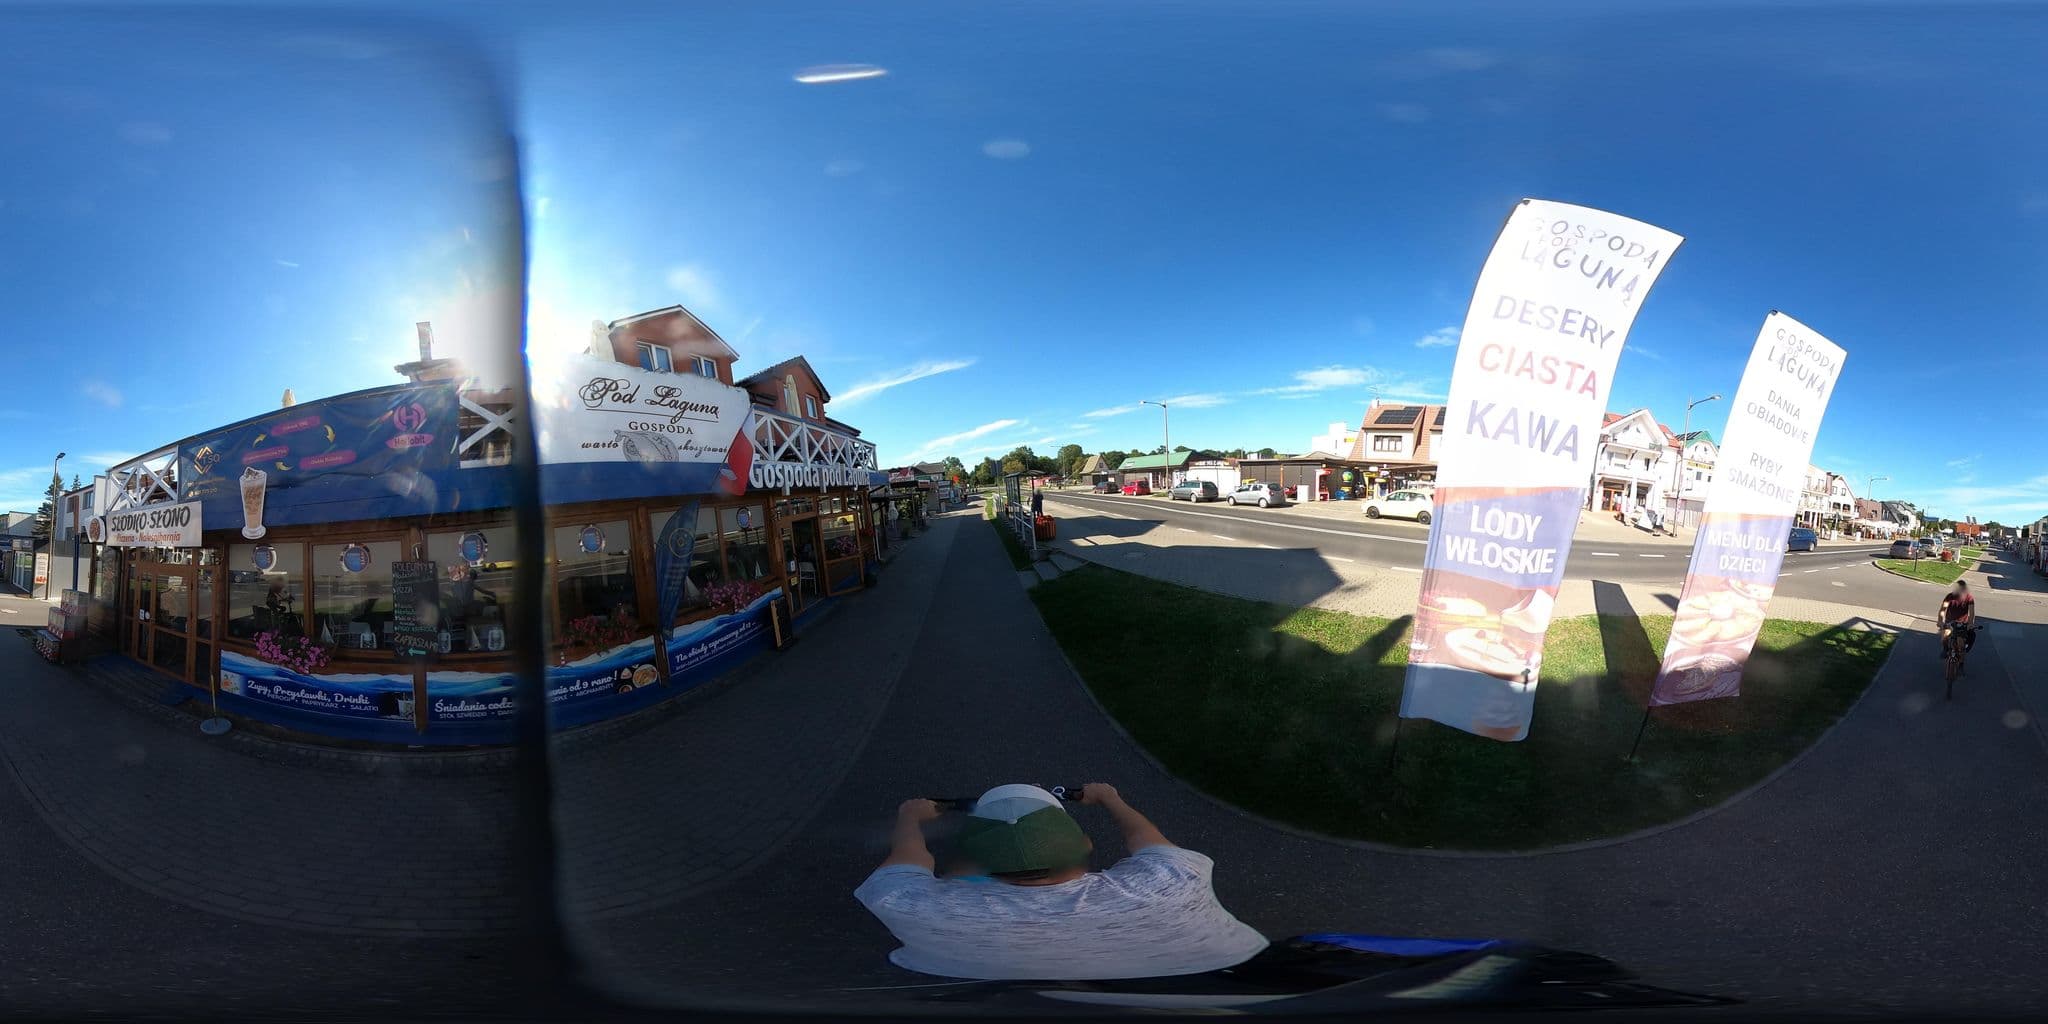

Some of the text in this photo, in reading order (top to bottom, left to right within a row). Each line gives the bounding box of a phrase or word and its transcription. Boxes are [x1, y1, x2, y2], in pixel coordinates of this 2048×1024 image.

[1492, 294, 1616, 351] DESERY
[1776, 327, 1836, 377] GOSPODA
[1479, 342, 1598, 401] CIASTA
[578, 376, 641, 409] Pod
[1767, 389, 1802, 421] DANIA
[628, 420, 695, 436] GOSPODA
[1466, 399, 1580, 463] KAWA
[1746, 401, 1809, 444] OBIADOWE
[581, 441, 619, 450] warto
[750, 461, 820, 496] Gospoda
[822, 463, 842, 493] pod
[1749, 451, 1783, 477] RYBY
[1728, 466, 1796, 504] SMAŻONE
[1470, 504, 1543, 543] LODY
[1707, 527, 1781, 553] MENU DLA
[1445, 534, 1557, 575] WŁOSKIE
[1719, 554, 1767, 573] DZIECI
[675, 653, 688, 664] Na
[247, 680, 271, 695] Zupy,
[334, 692, 370, 706] Drinki
[434, 698, 487, 713] Śniadania
[582, 681, 589, 690] 9
